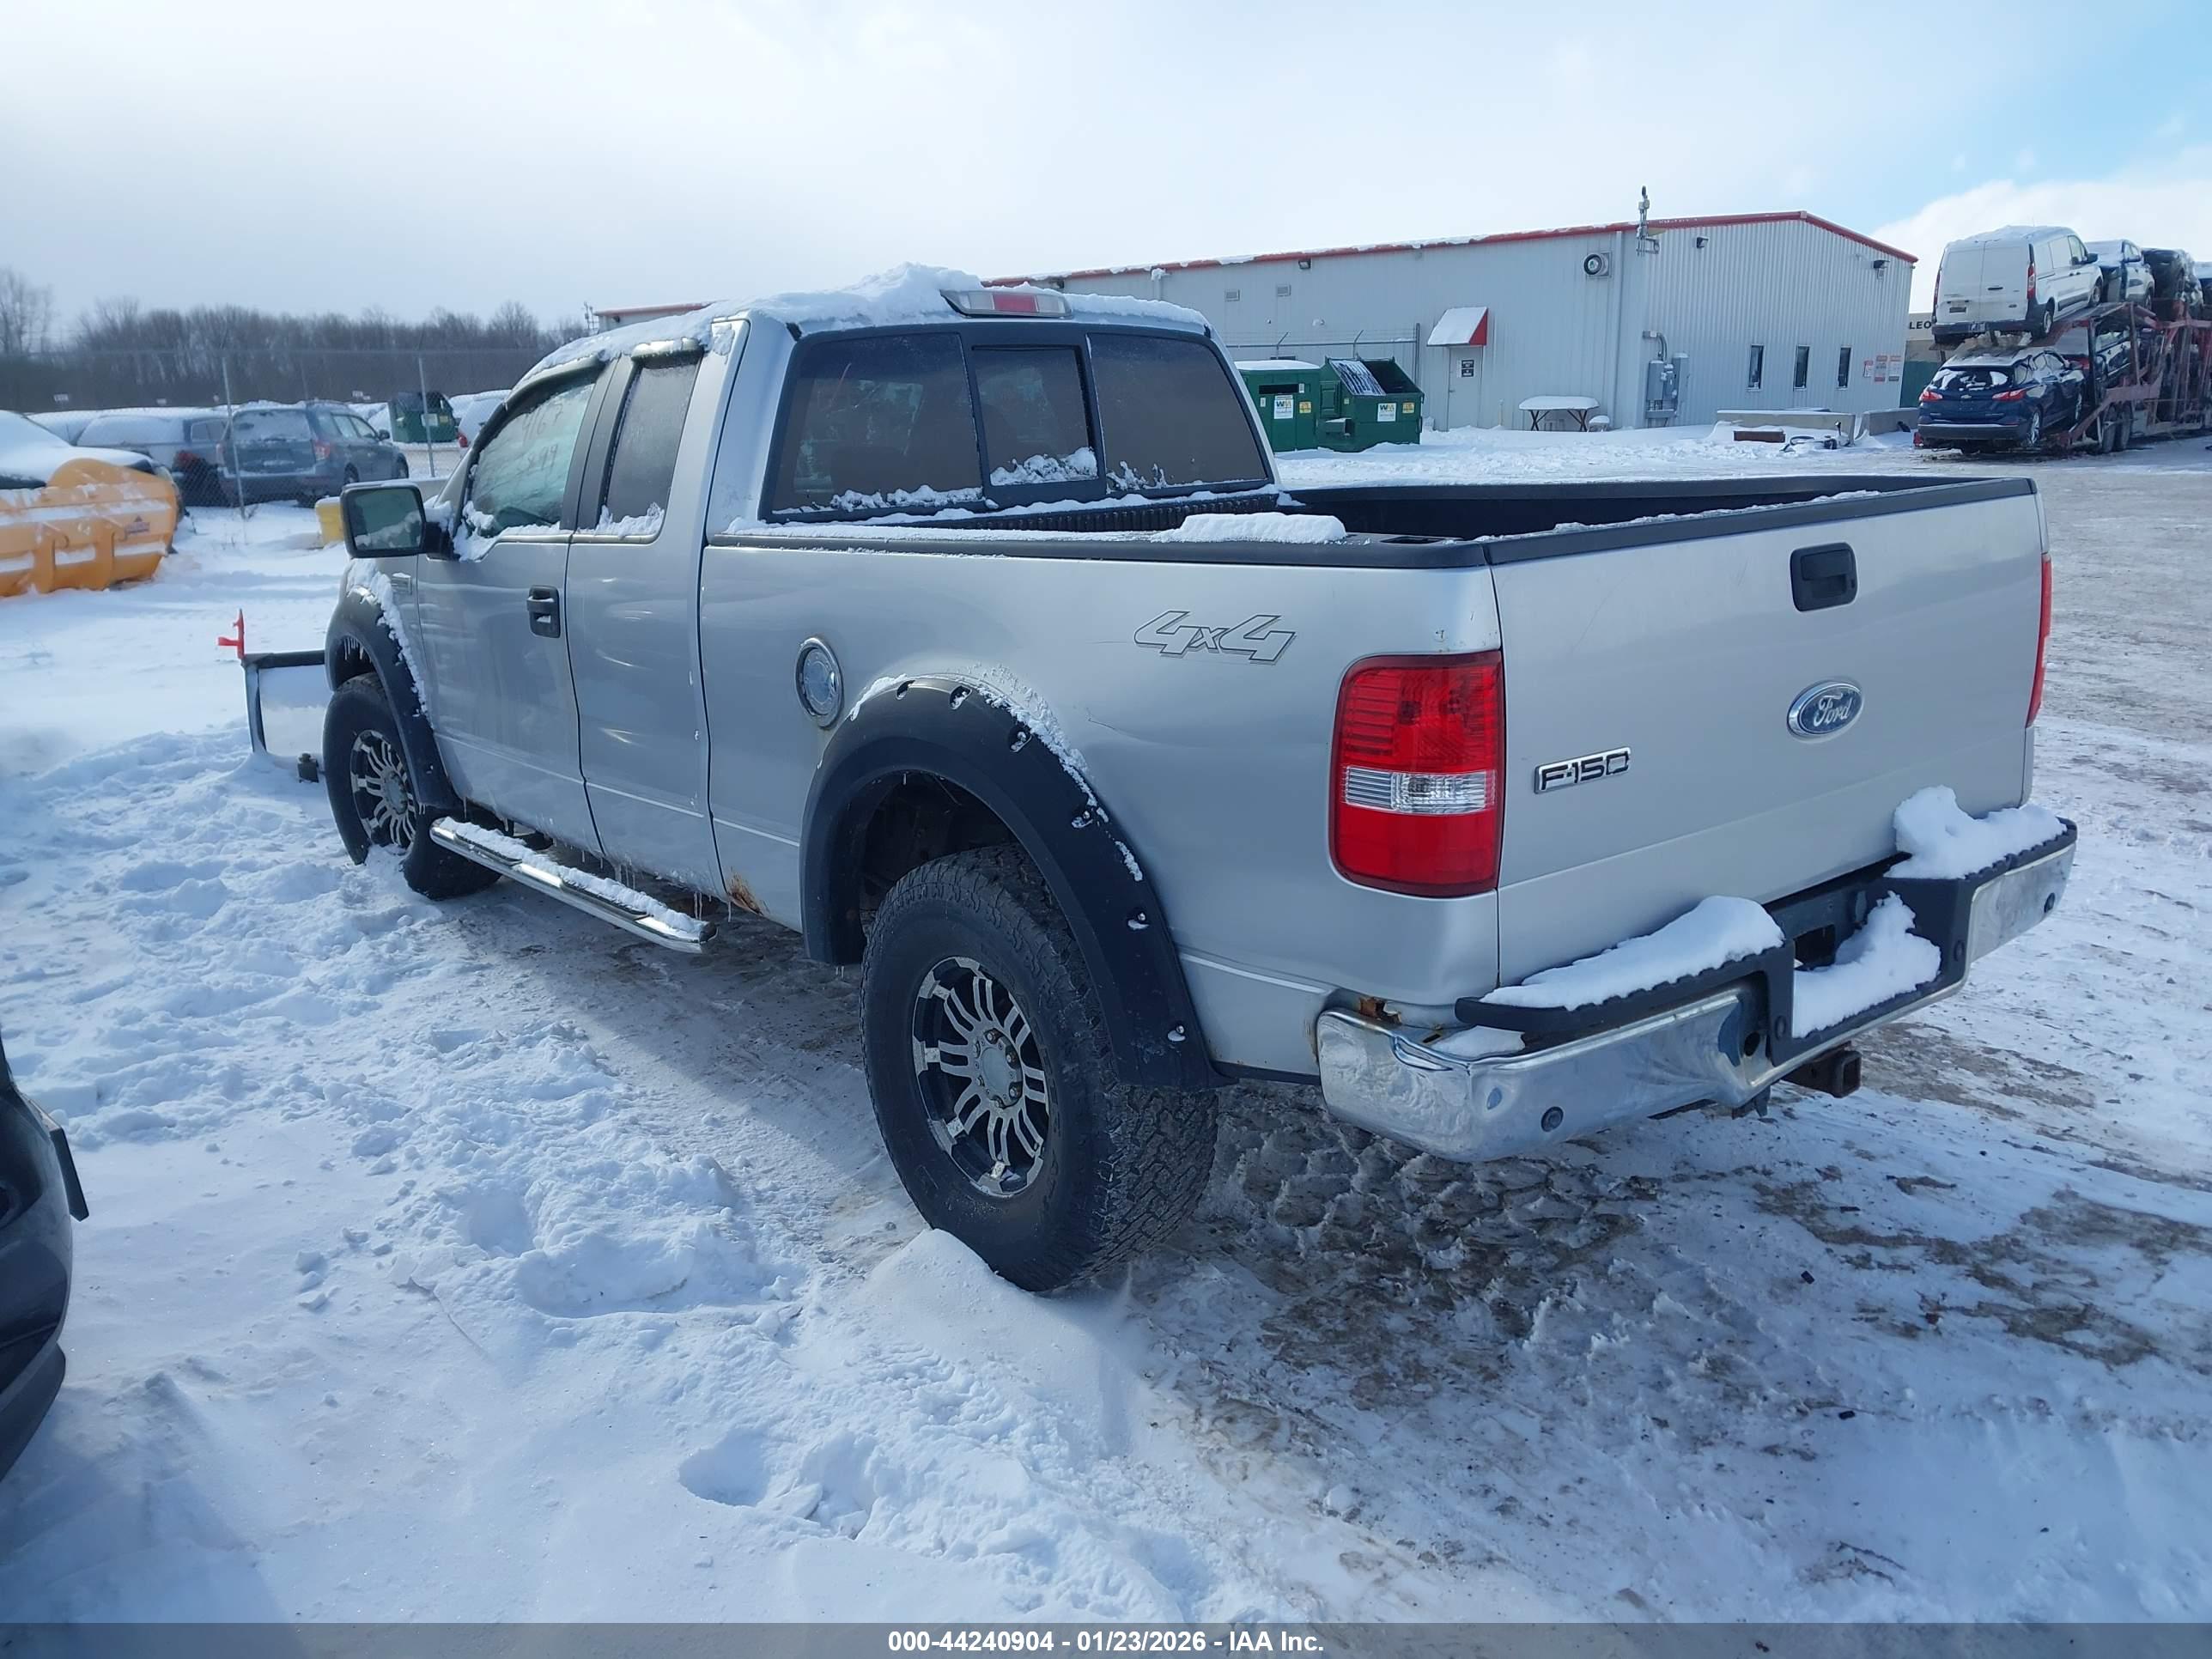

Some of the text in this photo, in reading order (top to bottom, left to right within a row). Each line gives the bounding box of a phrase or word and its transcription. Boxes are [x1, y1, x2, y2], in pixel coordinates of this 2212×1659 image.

[1909, 320, 1932, 330] LEO
[1134, 610, 1297, 665] 4x4
[1813, 693, 1853, 727] Ford
[1540, 750, 1630, 791] F-150
